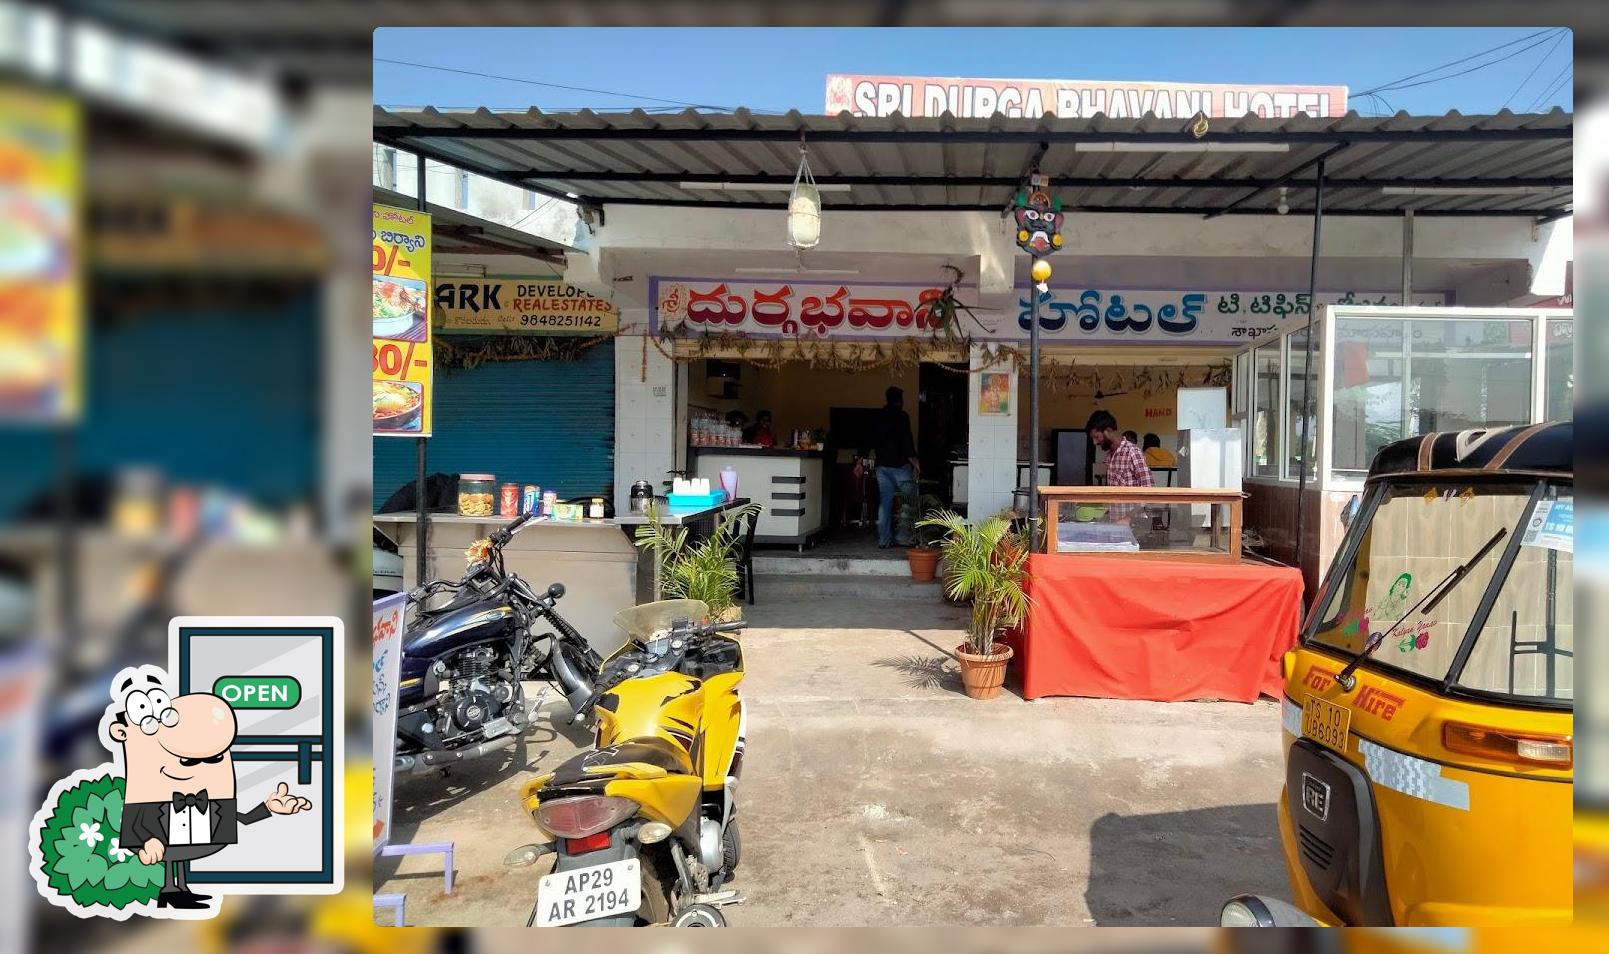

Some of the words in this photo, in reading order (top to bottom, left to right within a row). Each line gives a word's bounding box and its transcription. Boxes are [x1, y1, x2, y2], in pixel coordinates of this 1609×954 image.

[855, 81, 912, 117] SRI
[924, 84, 1045, 118] DURGA
[381, 230, 425, 252] బిర్యాని
[519, 314, 601, 327] 9848251142
[373, 341, 428, 380] 0/-
[1145, 408, 1172, 418] HAND
[1303, 666, 1336, 691] For
[1352, 684, 1407, 721] Hire
[1310, 699, 1321, 719] TS
[1328, 707, 1341, 727] 10
[564, 868, 613, 895] AP29
[547, 899, 575, 921] AR
[585, 888, 629, 915] 2194
